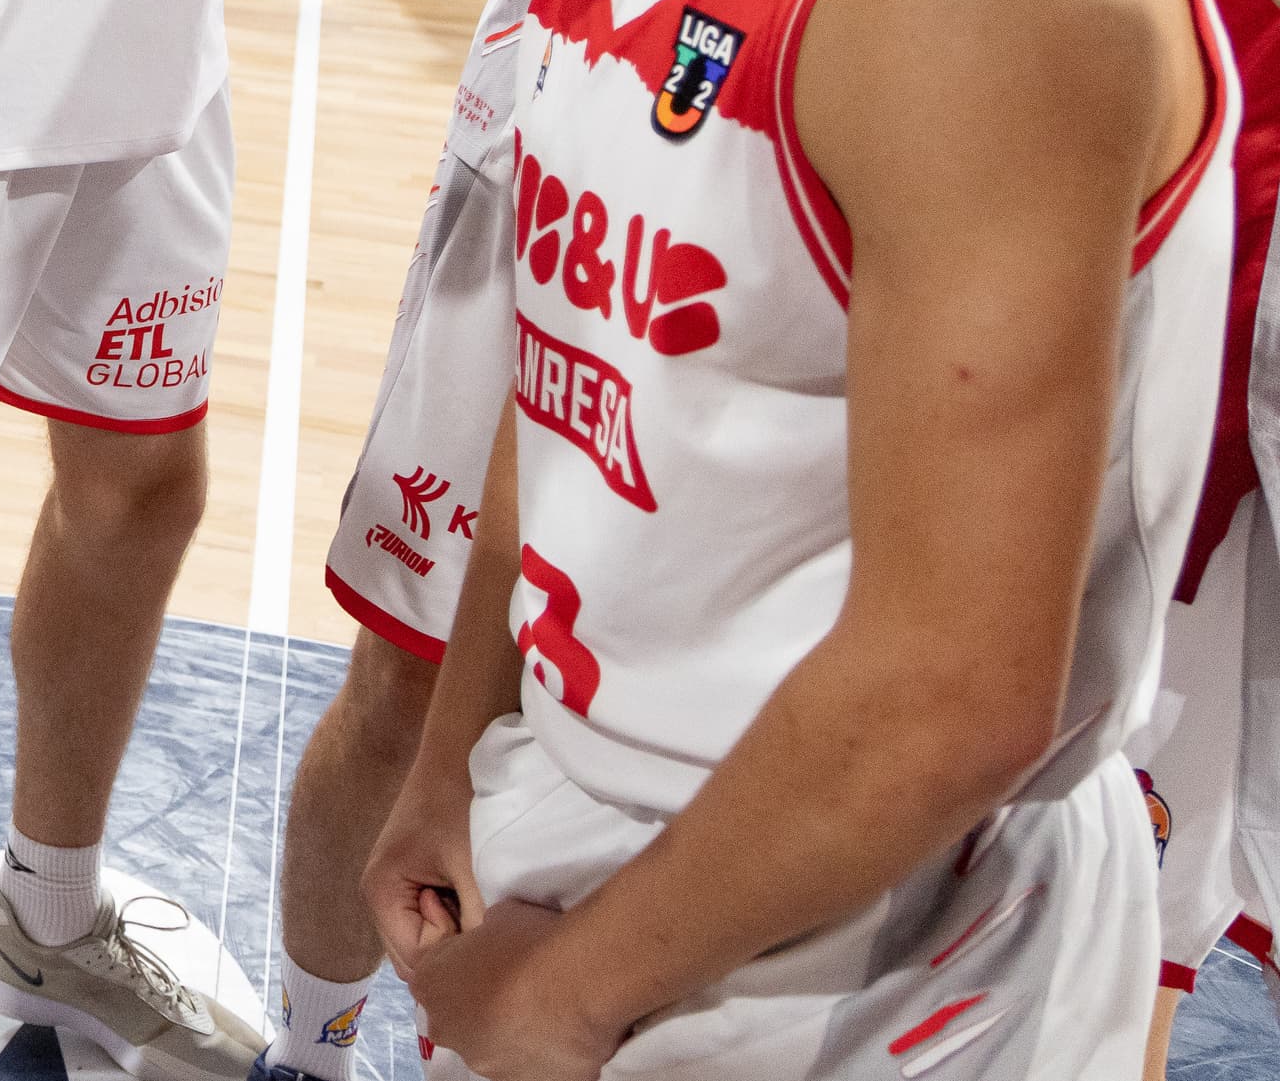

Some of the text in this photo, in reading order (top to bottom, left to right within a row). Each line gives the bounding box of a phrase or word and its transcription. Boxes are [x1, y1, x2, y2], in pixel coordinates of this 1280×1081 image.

[680, 15, 734, 66] LIGA
[95, 323, 173, 361] ETL
[86, 348, 207, 388] GLOBAL
[515, 323, 636, 487] ANRESA
